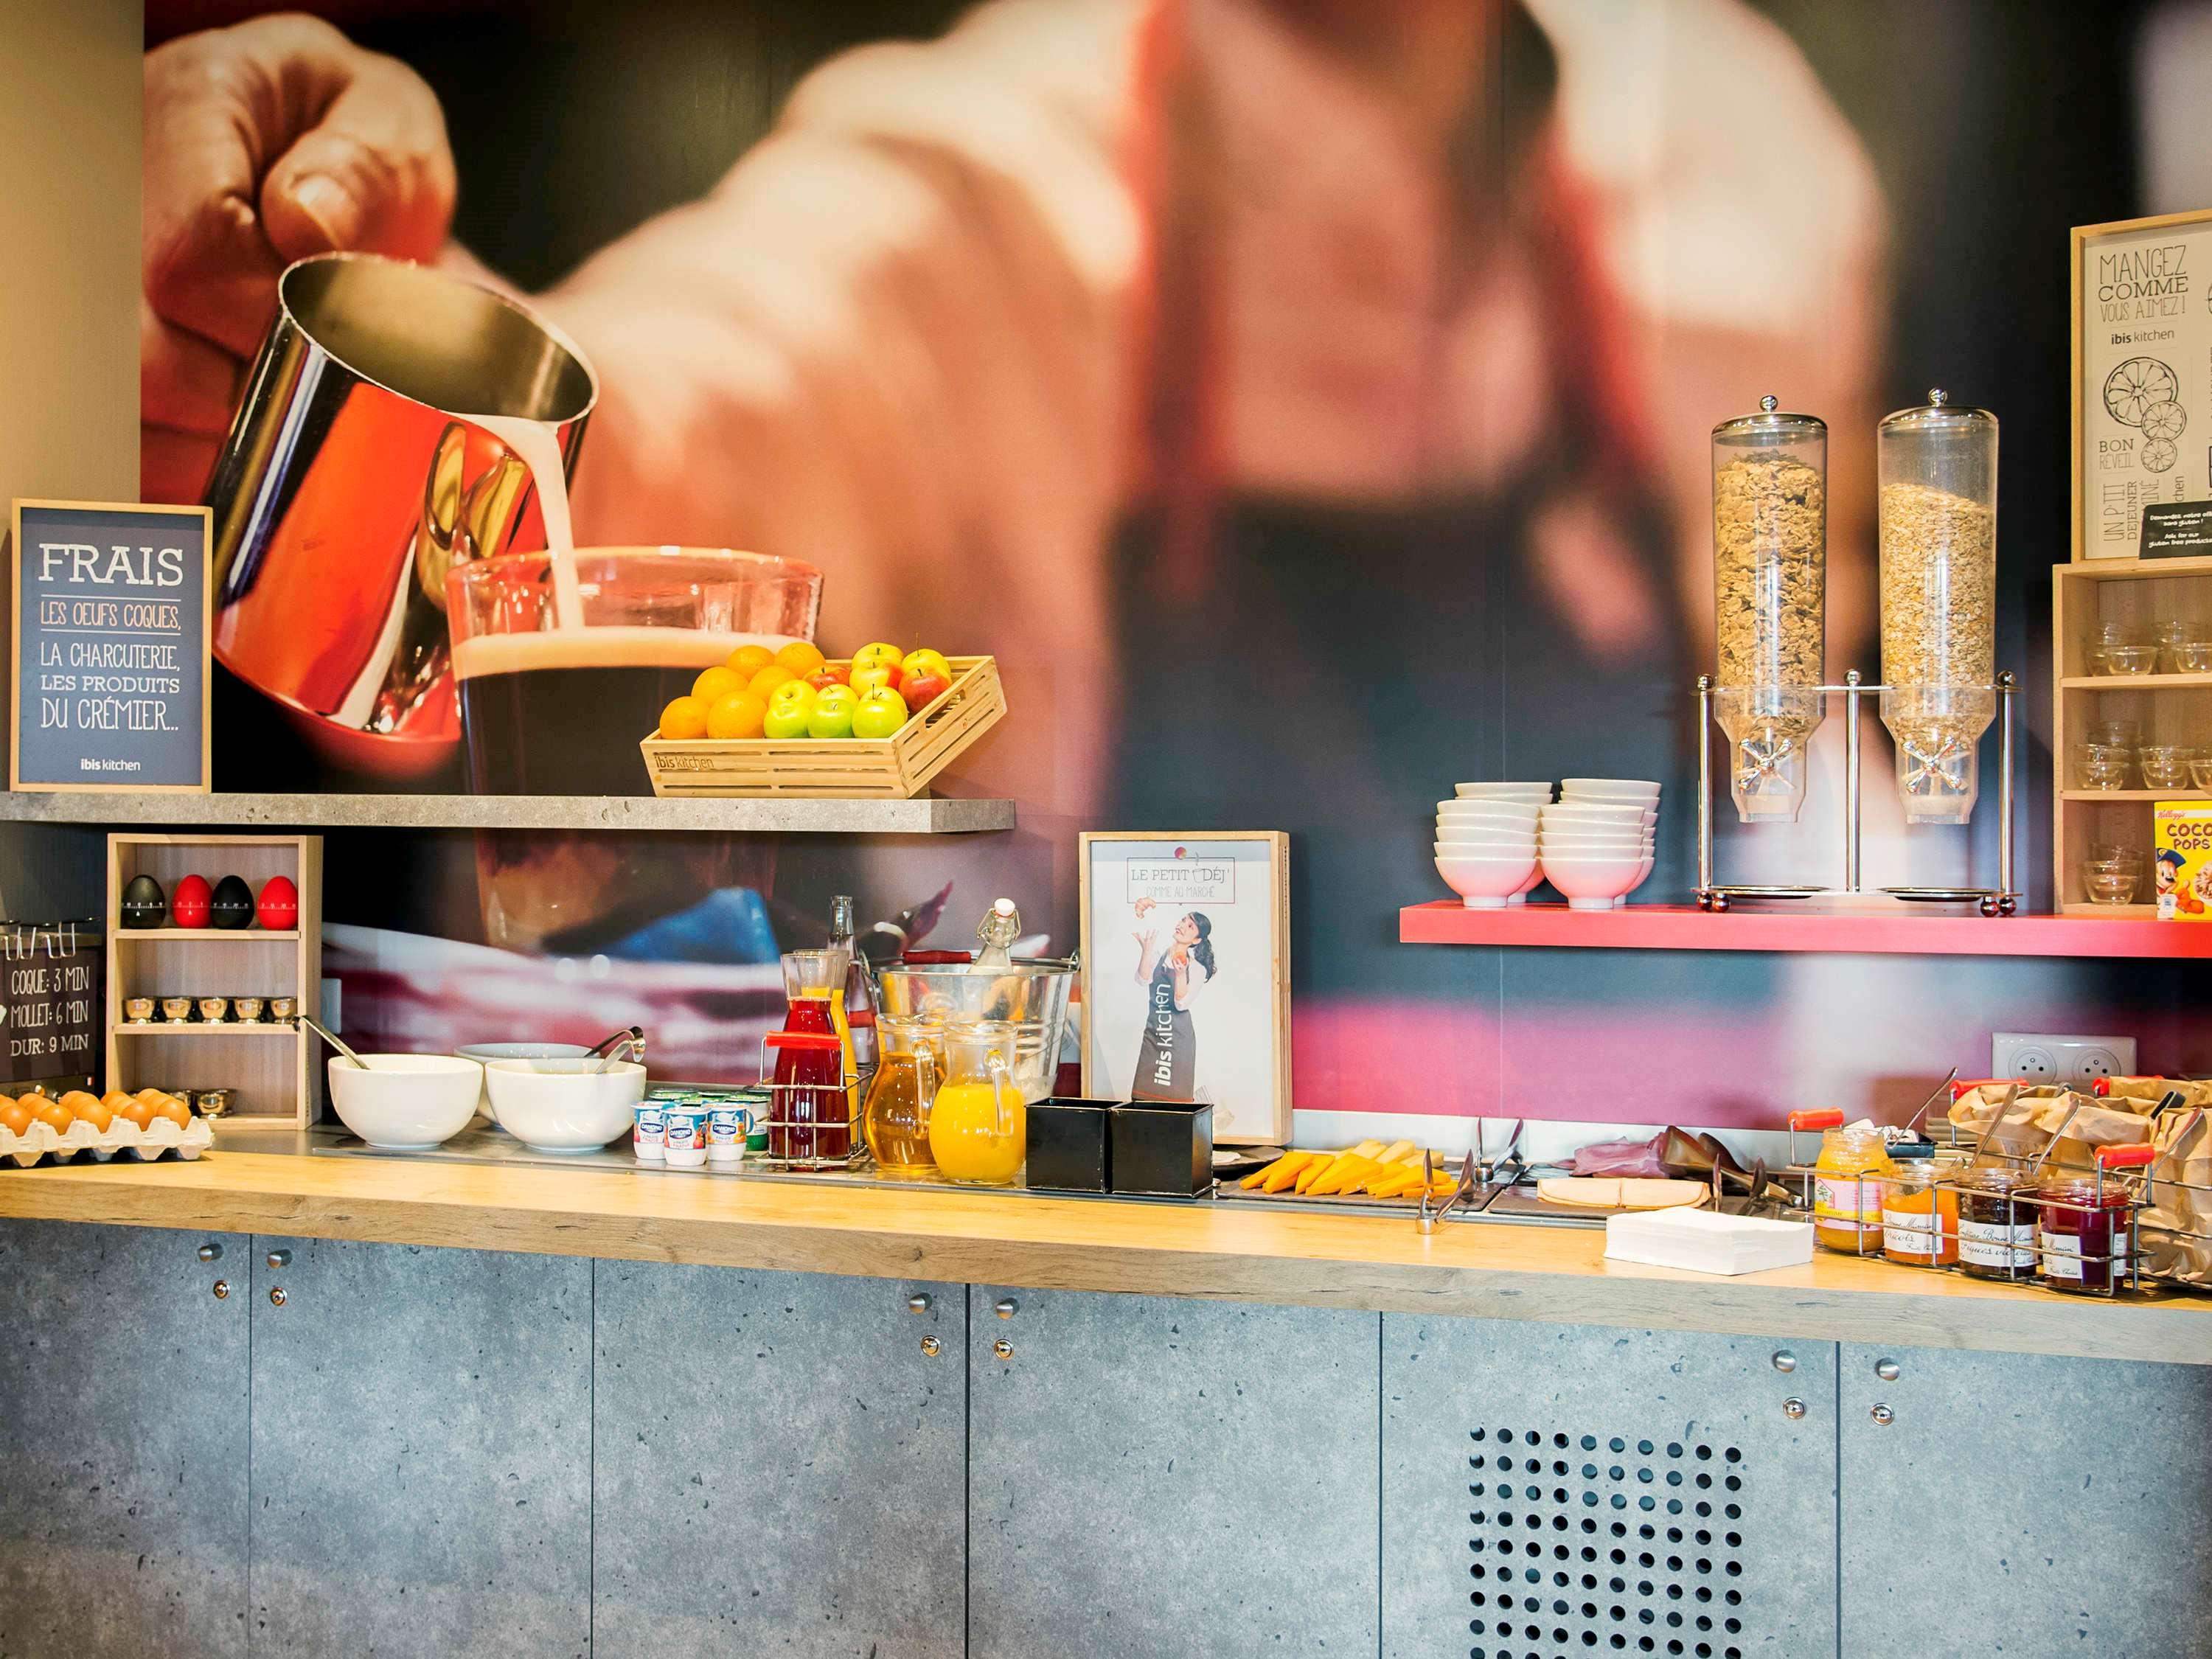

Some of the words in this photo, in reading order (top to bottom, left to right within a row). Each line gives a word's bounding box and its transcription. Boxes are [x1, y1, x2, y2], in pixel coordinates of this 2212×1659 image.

[2100, 244, 2187, 285] MANGEZ
[2098, 276, 2189, 302] COMME
[2100, 302, 2129, 323] VOUS
[2111, 333, 2132, 345] ibis
[2133, 330, 2174, 343] kitchen
[2099, 438, 2134, 453] BON
[2173, 476, 2185, 502] chen
[2103, 522, 2125, 541] UN
[38, 543, 184, 587] FRAIS
[41, 601, 66, 625] LES
[124, 604, 181, 631] COQUES,
[41, 641, 63, 667] LA
[70, 643, 180, 672] CHARCUTERIE,
[41, 675, 76, 691] LES
[82, 676, 180, 694] PRODUITS
[41, 698, 68, 728] DU
[80, 758, 101, 771] ibis
[102, 759, 141, 771] kitchen
[655, 757, 675, 768] ibis
[675, 757, 714, 768] kitchen
[2166, 822, 2212, 837] COCO
[2173, 838, 2211, 849] POPS
[1131, 869, 1148, 880] LE
[1152, 869, 1190, 881] PETIT
[1174, 885, 1184, 897] AU
[11, 968, 50, 995] COQUE:
[54, 967, 62, 992] 3
[65, 965, 89, 992] MIN
[10, 1002, 53, 1029] MOLLET:
[56, 1002, 63, 1025] 6
[66, 999, 88, 1024] MIN
[1155, 983, 1173, 1048] kitchen
[10, 1037, 45, 1057] DUR:
[49, 1036, 57, 1054] 9
[60, 1033, 88, 1052] MIN
[1153, 1051, 1172, 1087] ibis
